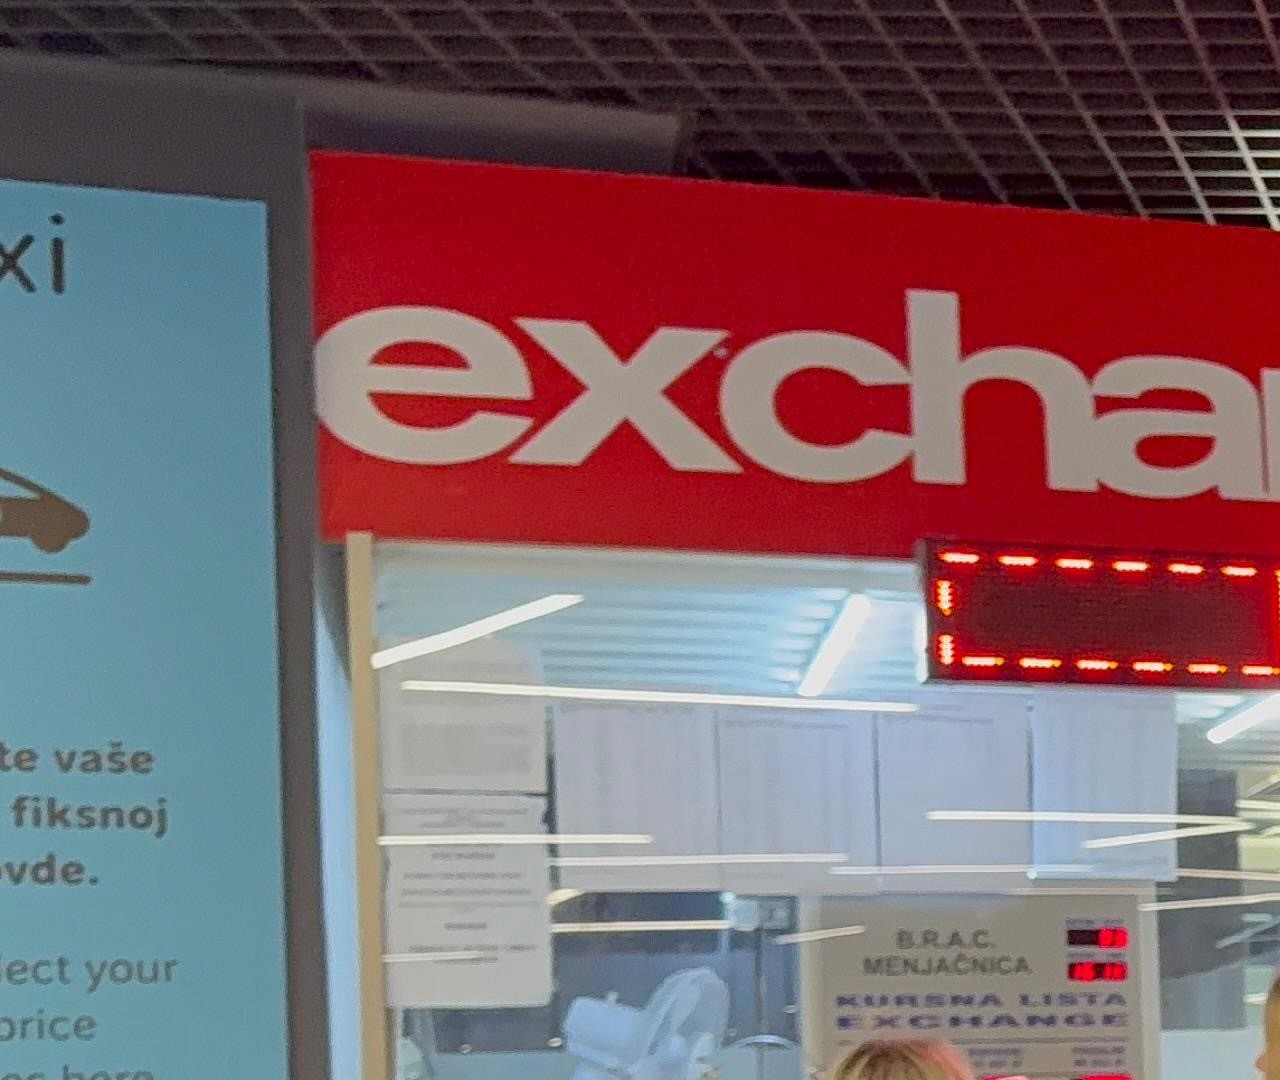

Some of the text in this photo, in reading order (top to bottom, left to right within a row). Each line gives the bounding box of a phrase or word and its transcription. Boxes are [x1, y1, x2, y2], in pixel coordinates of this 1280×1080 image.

[54, 740, 155, 774] vaše
[11, 796, 168, 839] fiksnoj
[0, 853, 98, 886] vde.
[0, 954, 178, 993] ect your
[862, 951, 1032, 976] MENJAČNICA
[836, 991, 1128, 1008] KURSNA LISTA
[836, 1012, 1129, 1031] EXCHANGE
